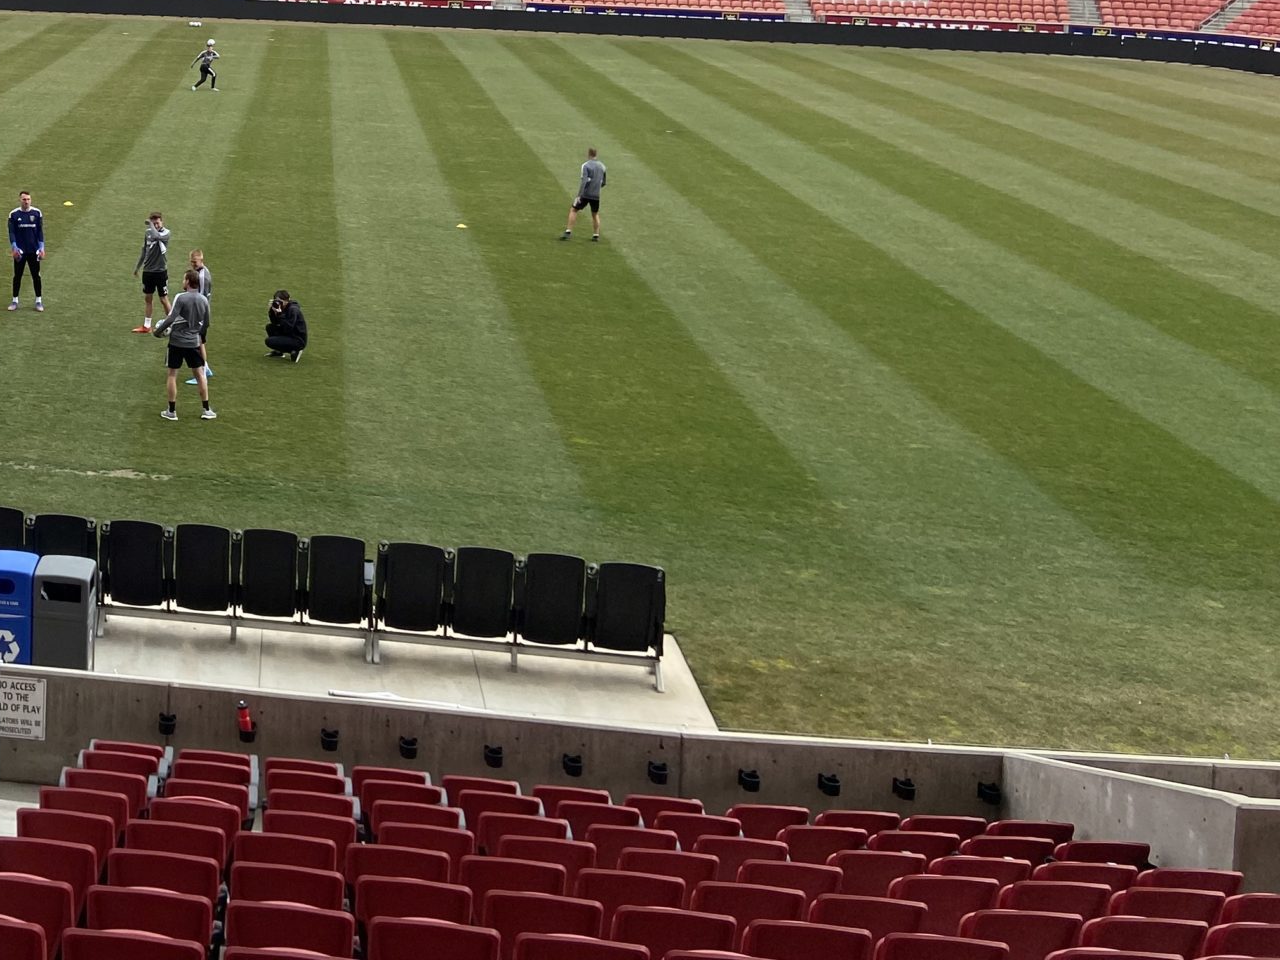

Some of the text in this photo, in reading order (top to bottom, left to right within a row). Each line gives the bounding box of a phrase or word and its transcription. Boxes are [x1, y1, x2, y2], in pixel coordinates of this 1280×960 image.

[10, 681, 36, 692] ACCESS
[3, 692, 30, 702] TO THE
[11, 704, 20, 712] OF
[23, 705, 41, 715] PLAY
